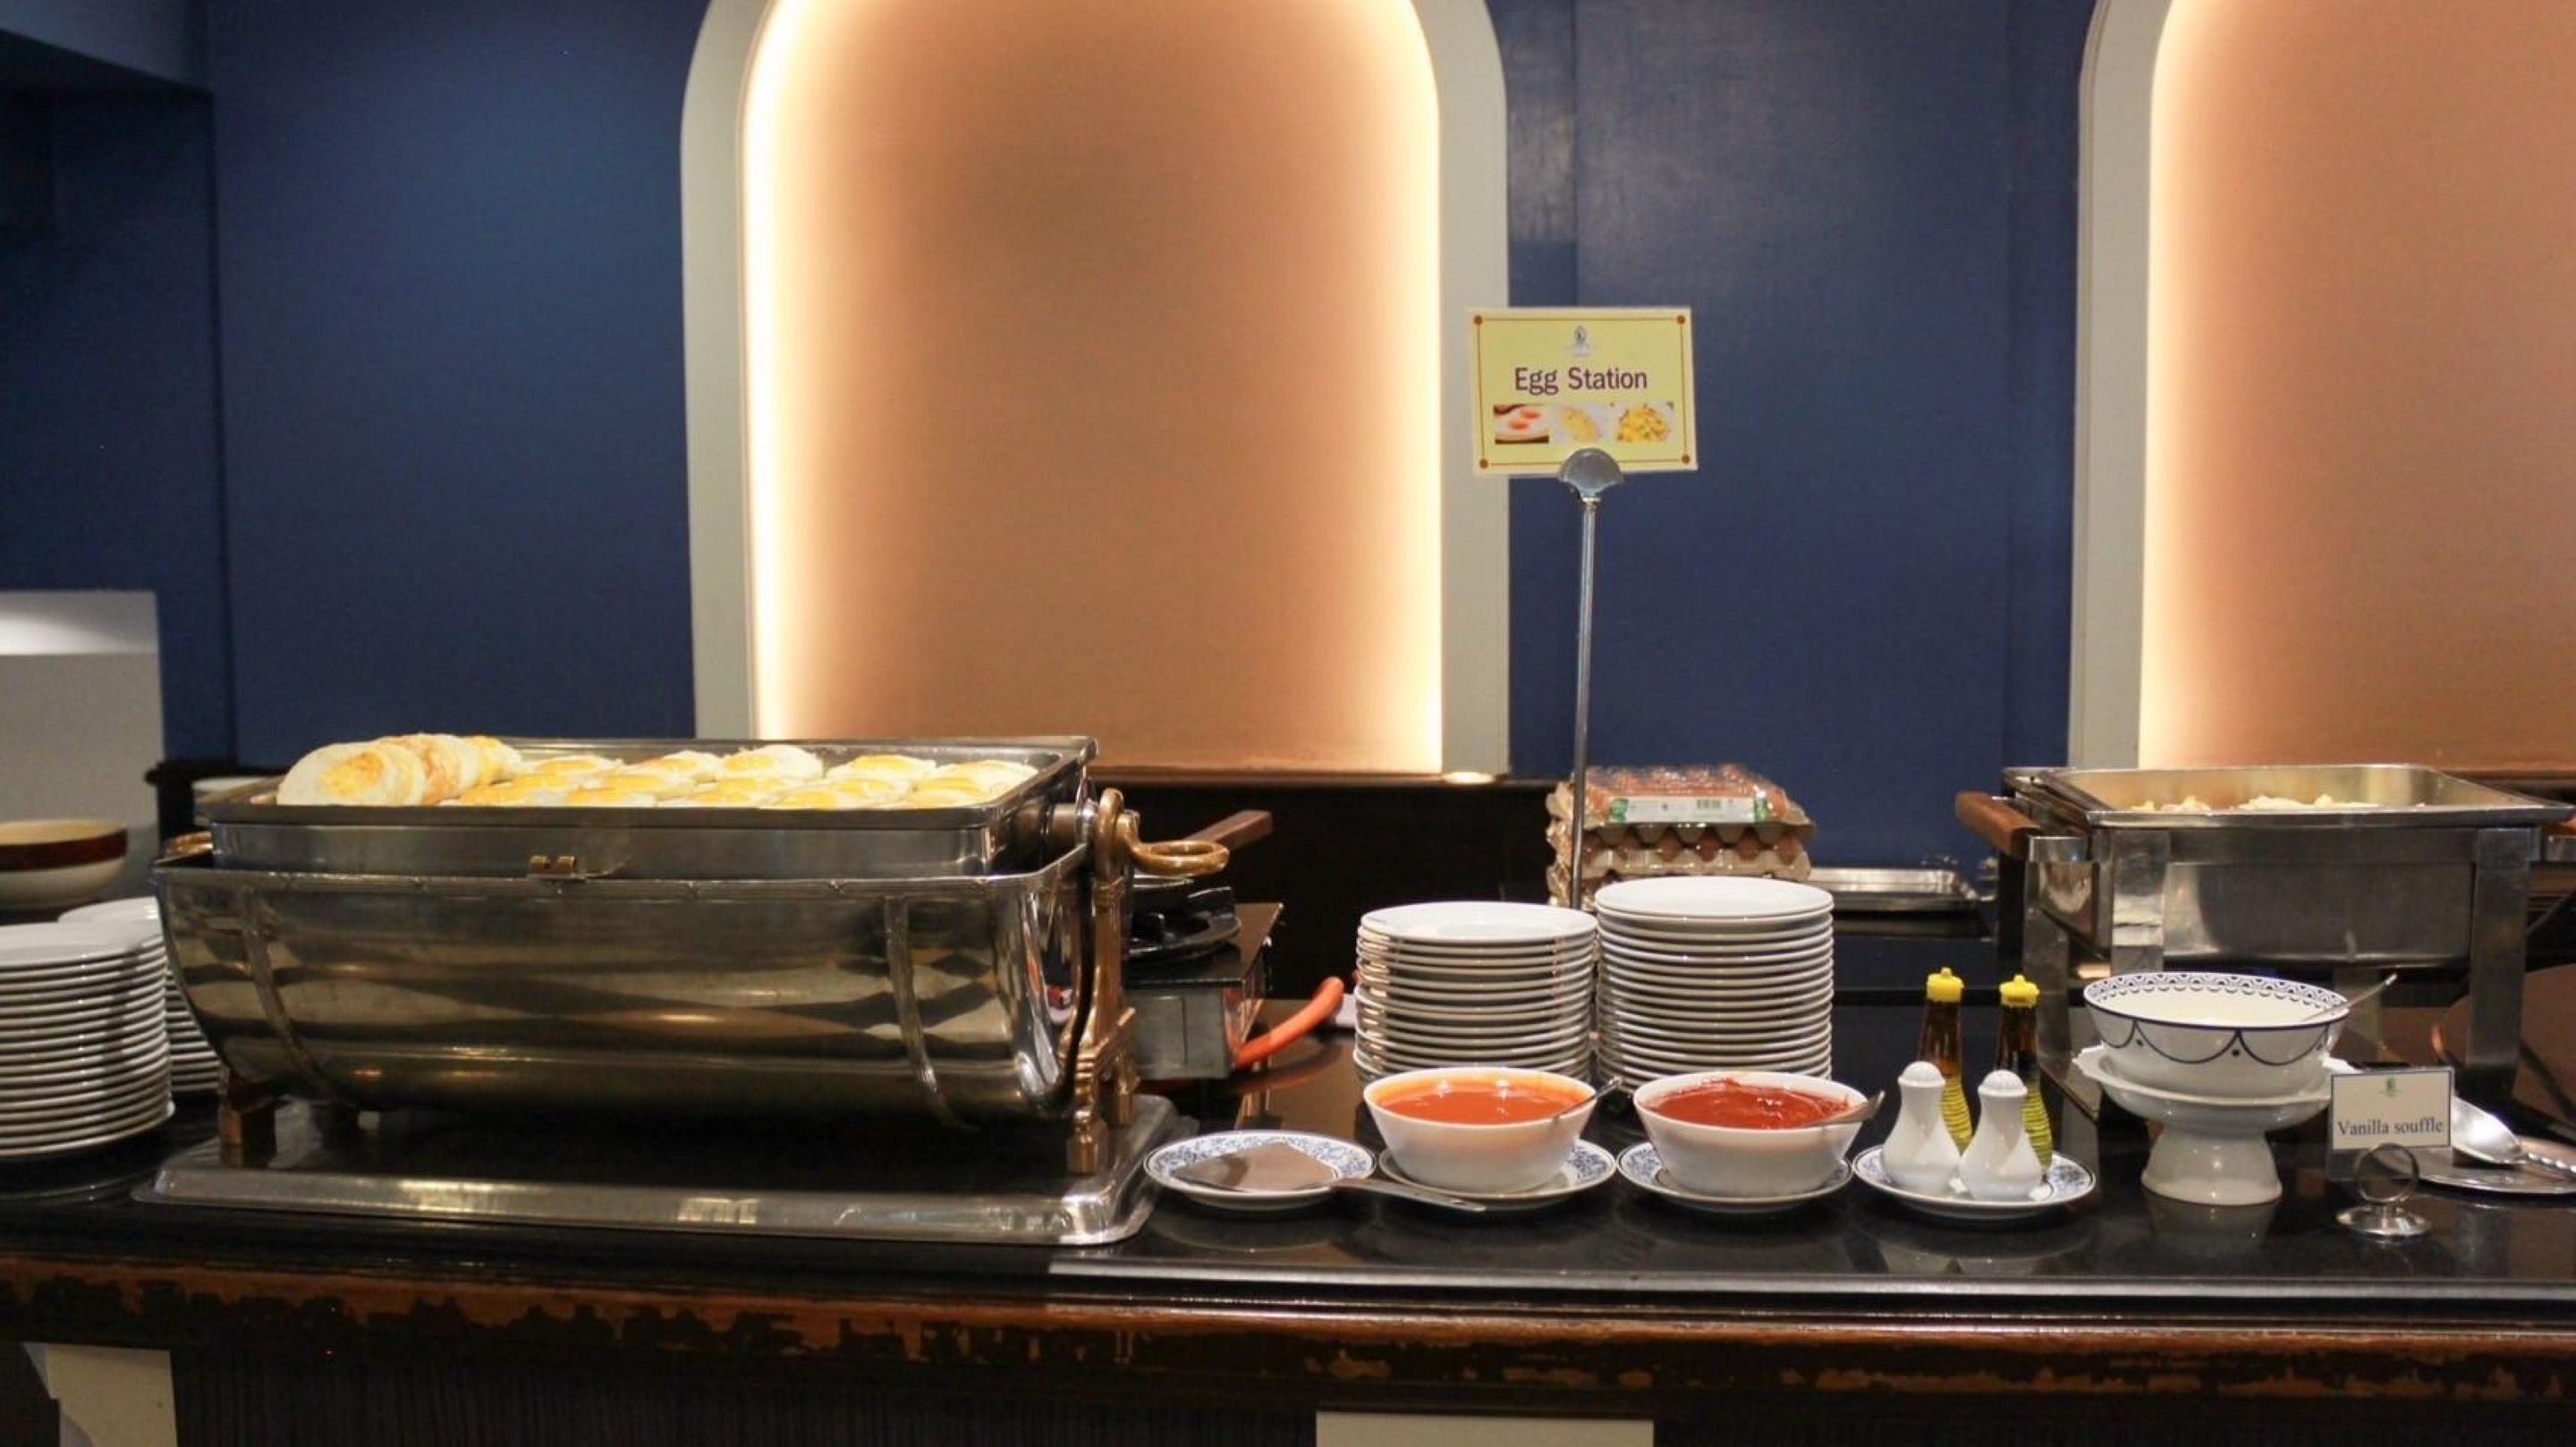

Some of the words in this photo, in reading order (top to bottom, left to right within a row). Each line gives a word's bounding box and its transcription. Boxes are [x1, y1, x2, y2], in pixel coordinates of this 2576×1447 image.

[1514, 367, 1559, 395] Egg
[1568, 367, 1648, 390] Station
[2338, 1118, 2389, 1136] Vanilla
[2394, 1116, 2444, 1133] souffle
